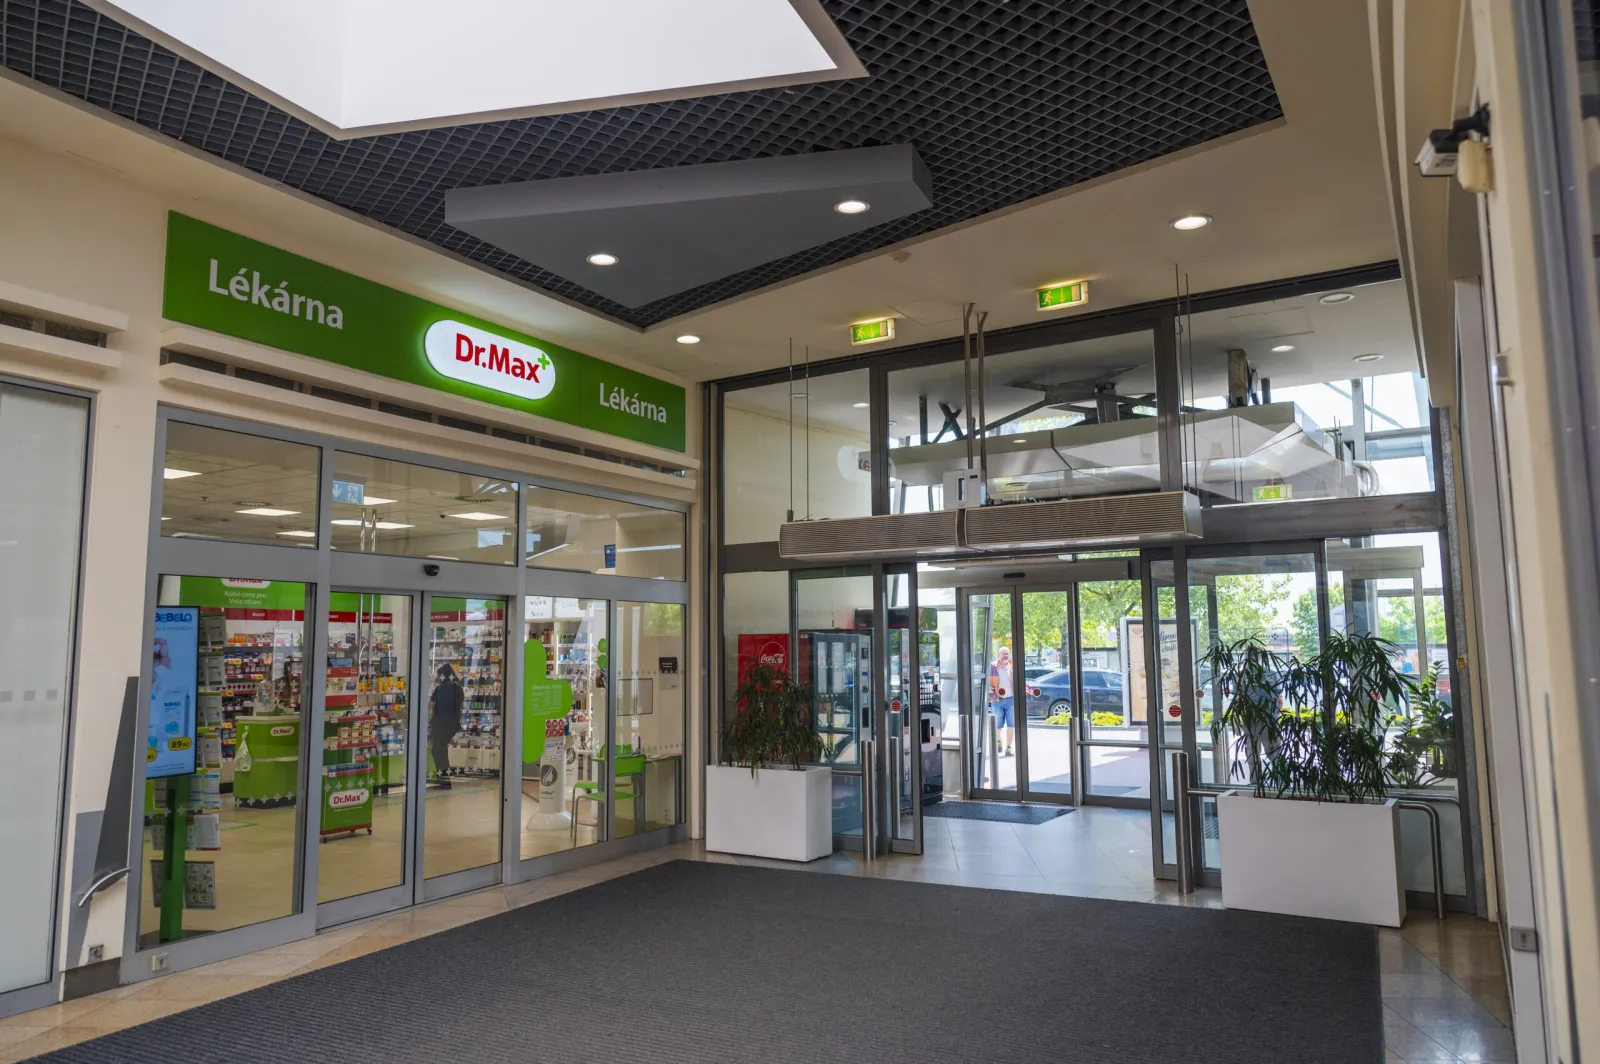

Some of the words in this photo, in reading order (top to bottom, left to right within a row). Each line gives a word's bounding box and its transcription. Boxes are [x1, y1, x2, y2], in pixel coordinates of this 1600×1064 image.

[209, 258, 344, 331] Lékárna
[455, 333, 541, 384] Dr.Max
[599, 383, 667, 425] Lékárna
[155, 612, 193, 622] BEBELO
[171, 740, 182, 748] 89
[333, 795, 361, 805] Dr.Max
